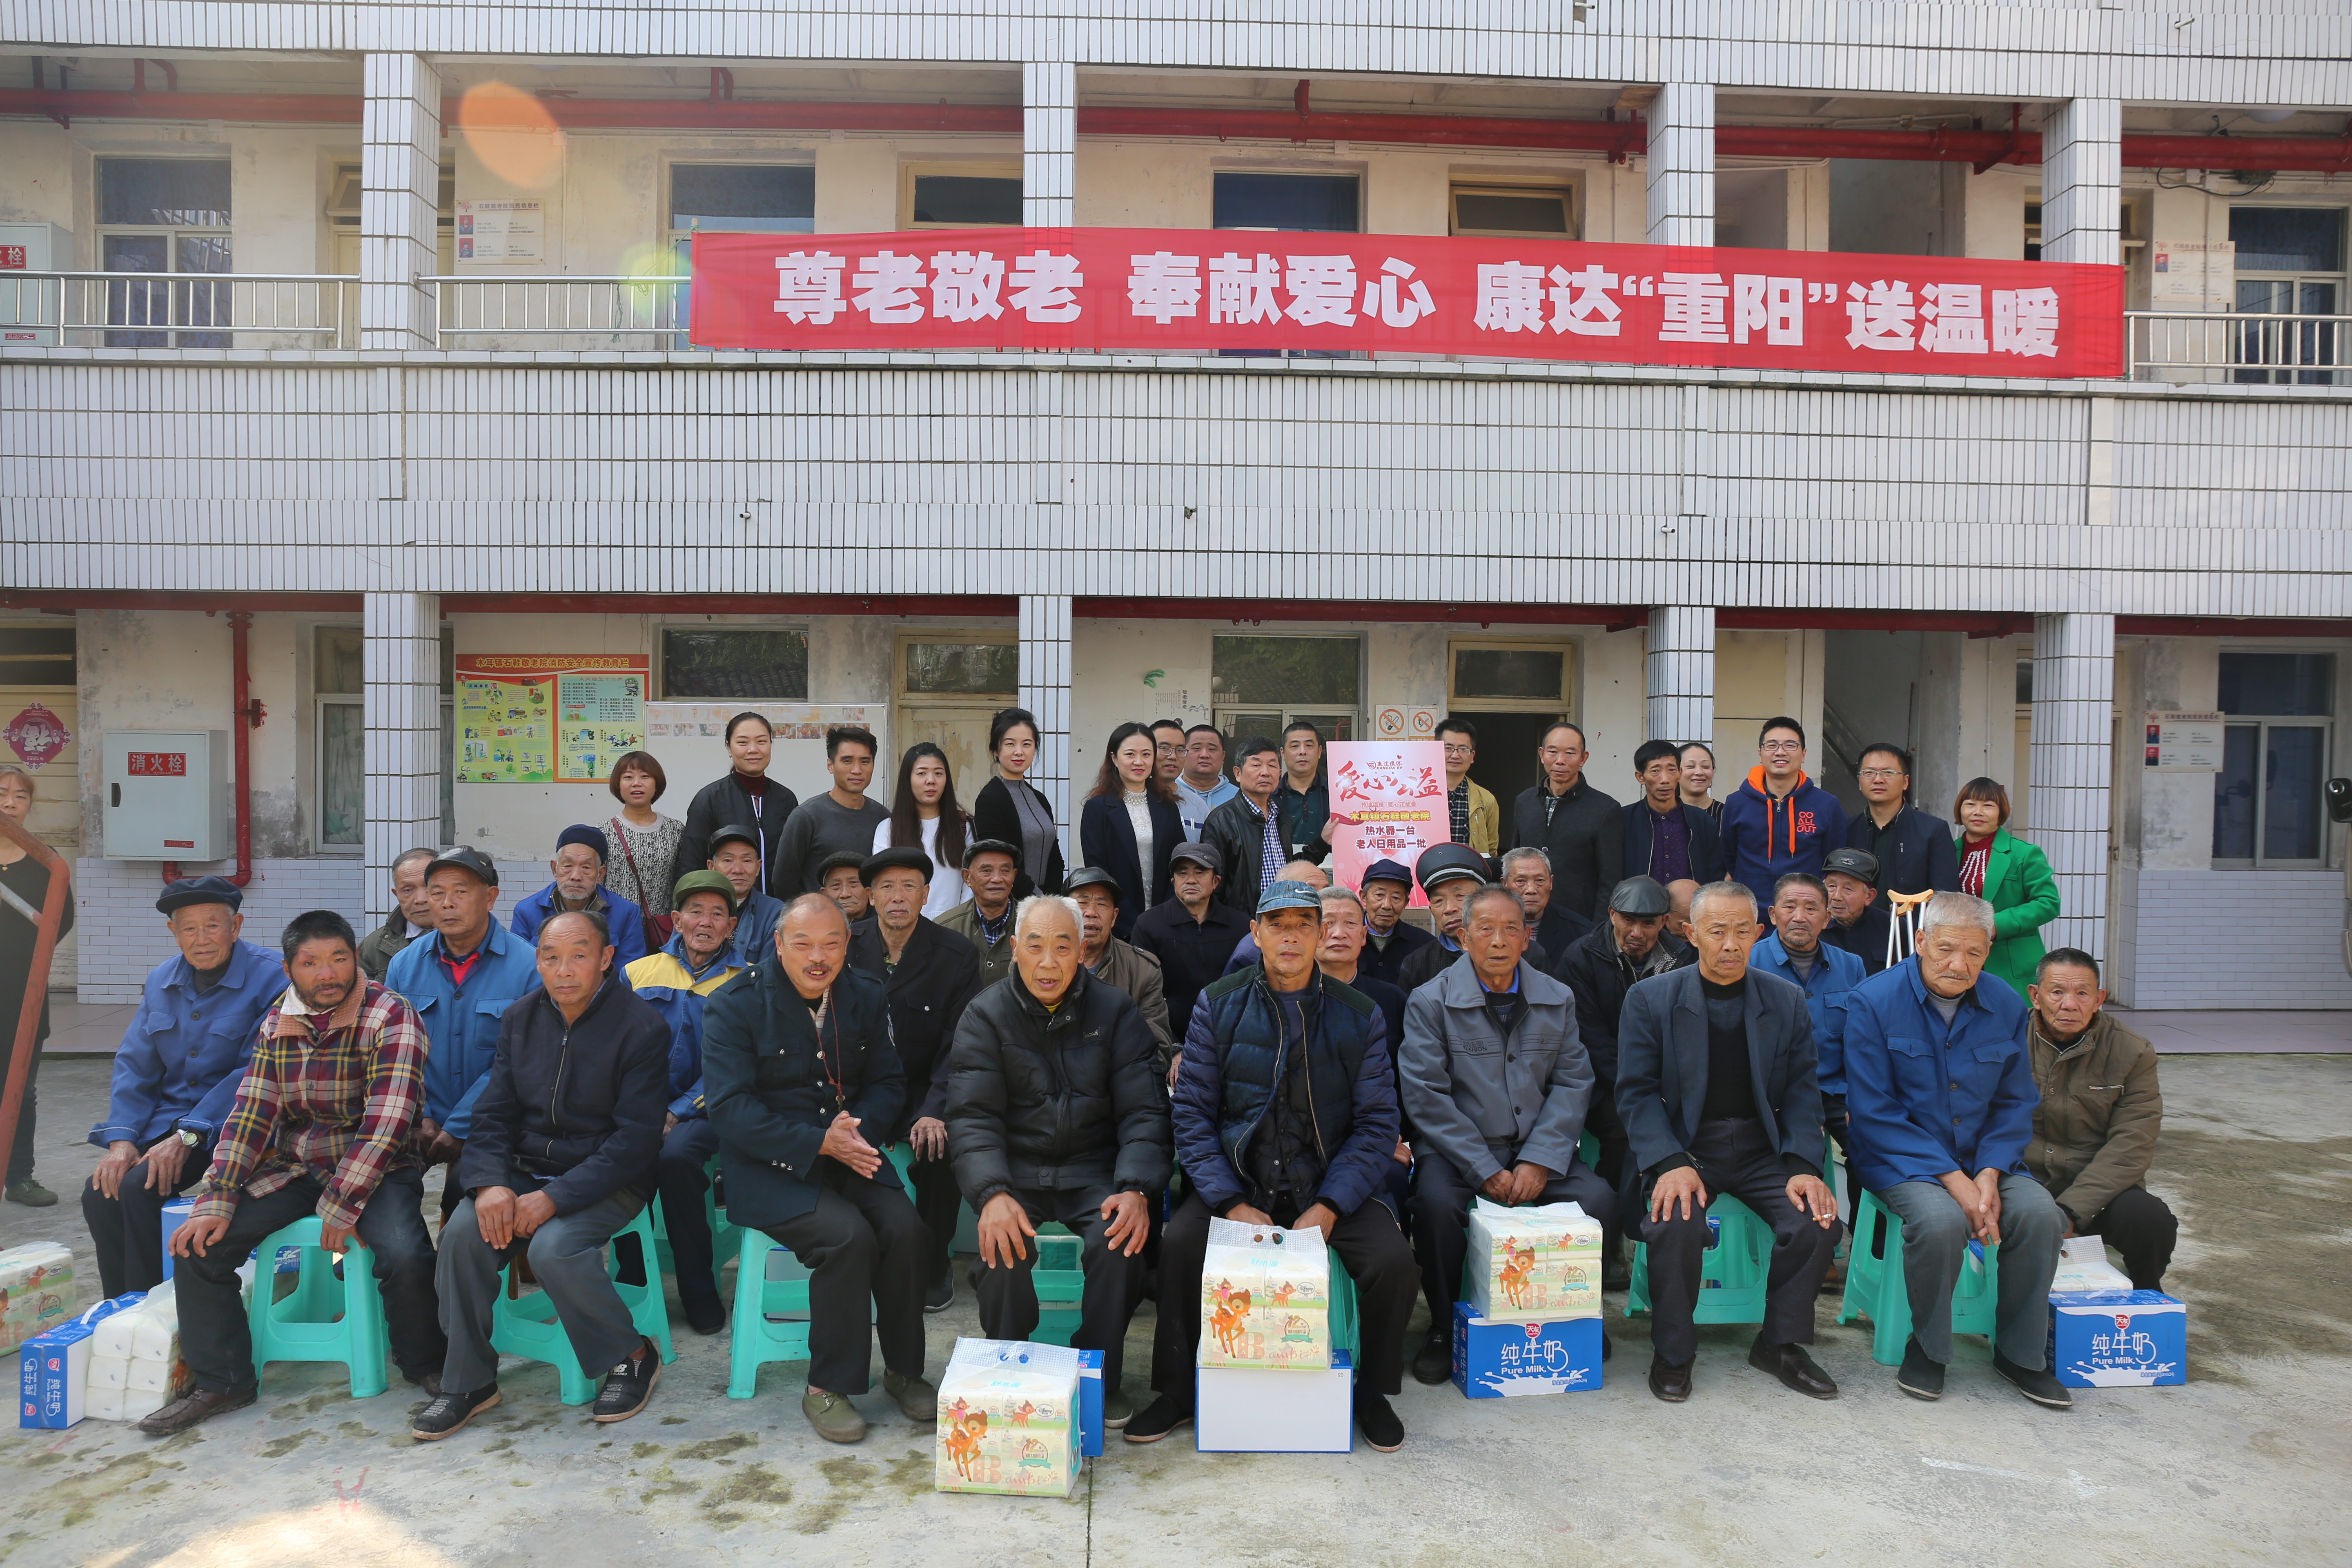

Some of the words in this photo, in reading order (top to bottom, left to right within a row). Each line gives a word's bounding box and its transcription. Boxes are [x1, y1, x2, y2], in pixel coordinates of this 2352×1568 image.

[0, 247, 22, 265] 栓
[773, 250, 1085, 326] 尊老敬老
[1127, 251, 1436, 328] 奉献爱心
[1473, 260, 2060, 358] 康达“重阳”送温暖
[476, 658, 629, 668] 木耳镇石鞋敬老院消防安全宣传教育栏
[20, 724, 52, 752] 福
[131, 755, 183, 772] 消火栓
[1350, 811, 1430, 822] 木耳镇石鞋敬老院
[1365, 826, 1415, 835] 热水器一台
[1356, 838, 1427, 849] 老人日用品一批
[1567, 1266, 1578, 1278] 12
[1288, 1315, 1300, 1328] 12
[1501, 1340, 1569, 1372] 纯牛奶
[2091, 1332, 2156, 1364] 纯牛奶
[24, 1358, 38, 1395] 纯牛奶
[46, 1379, 61, 1416] 纯牛奶
[1026, 1438, 1038, 1452] 12
